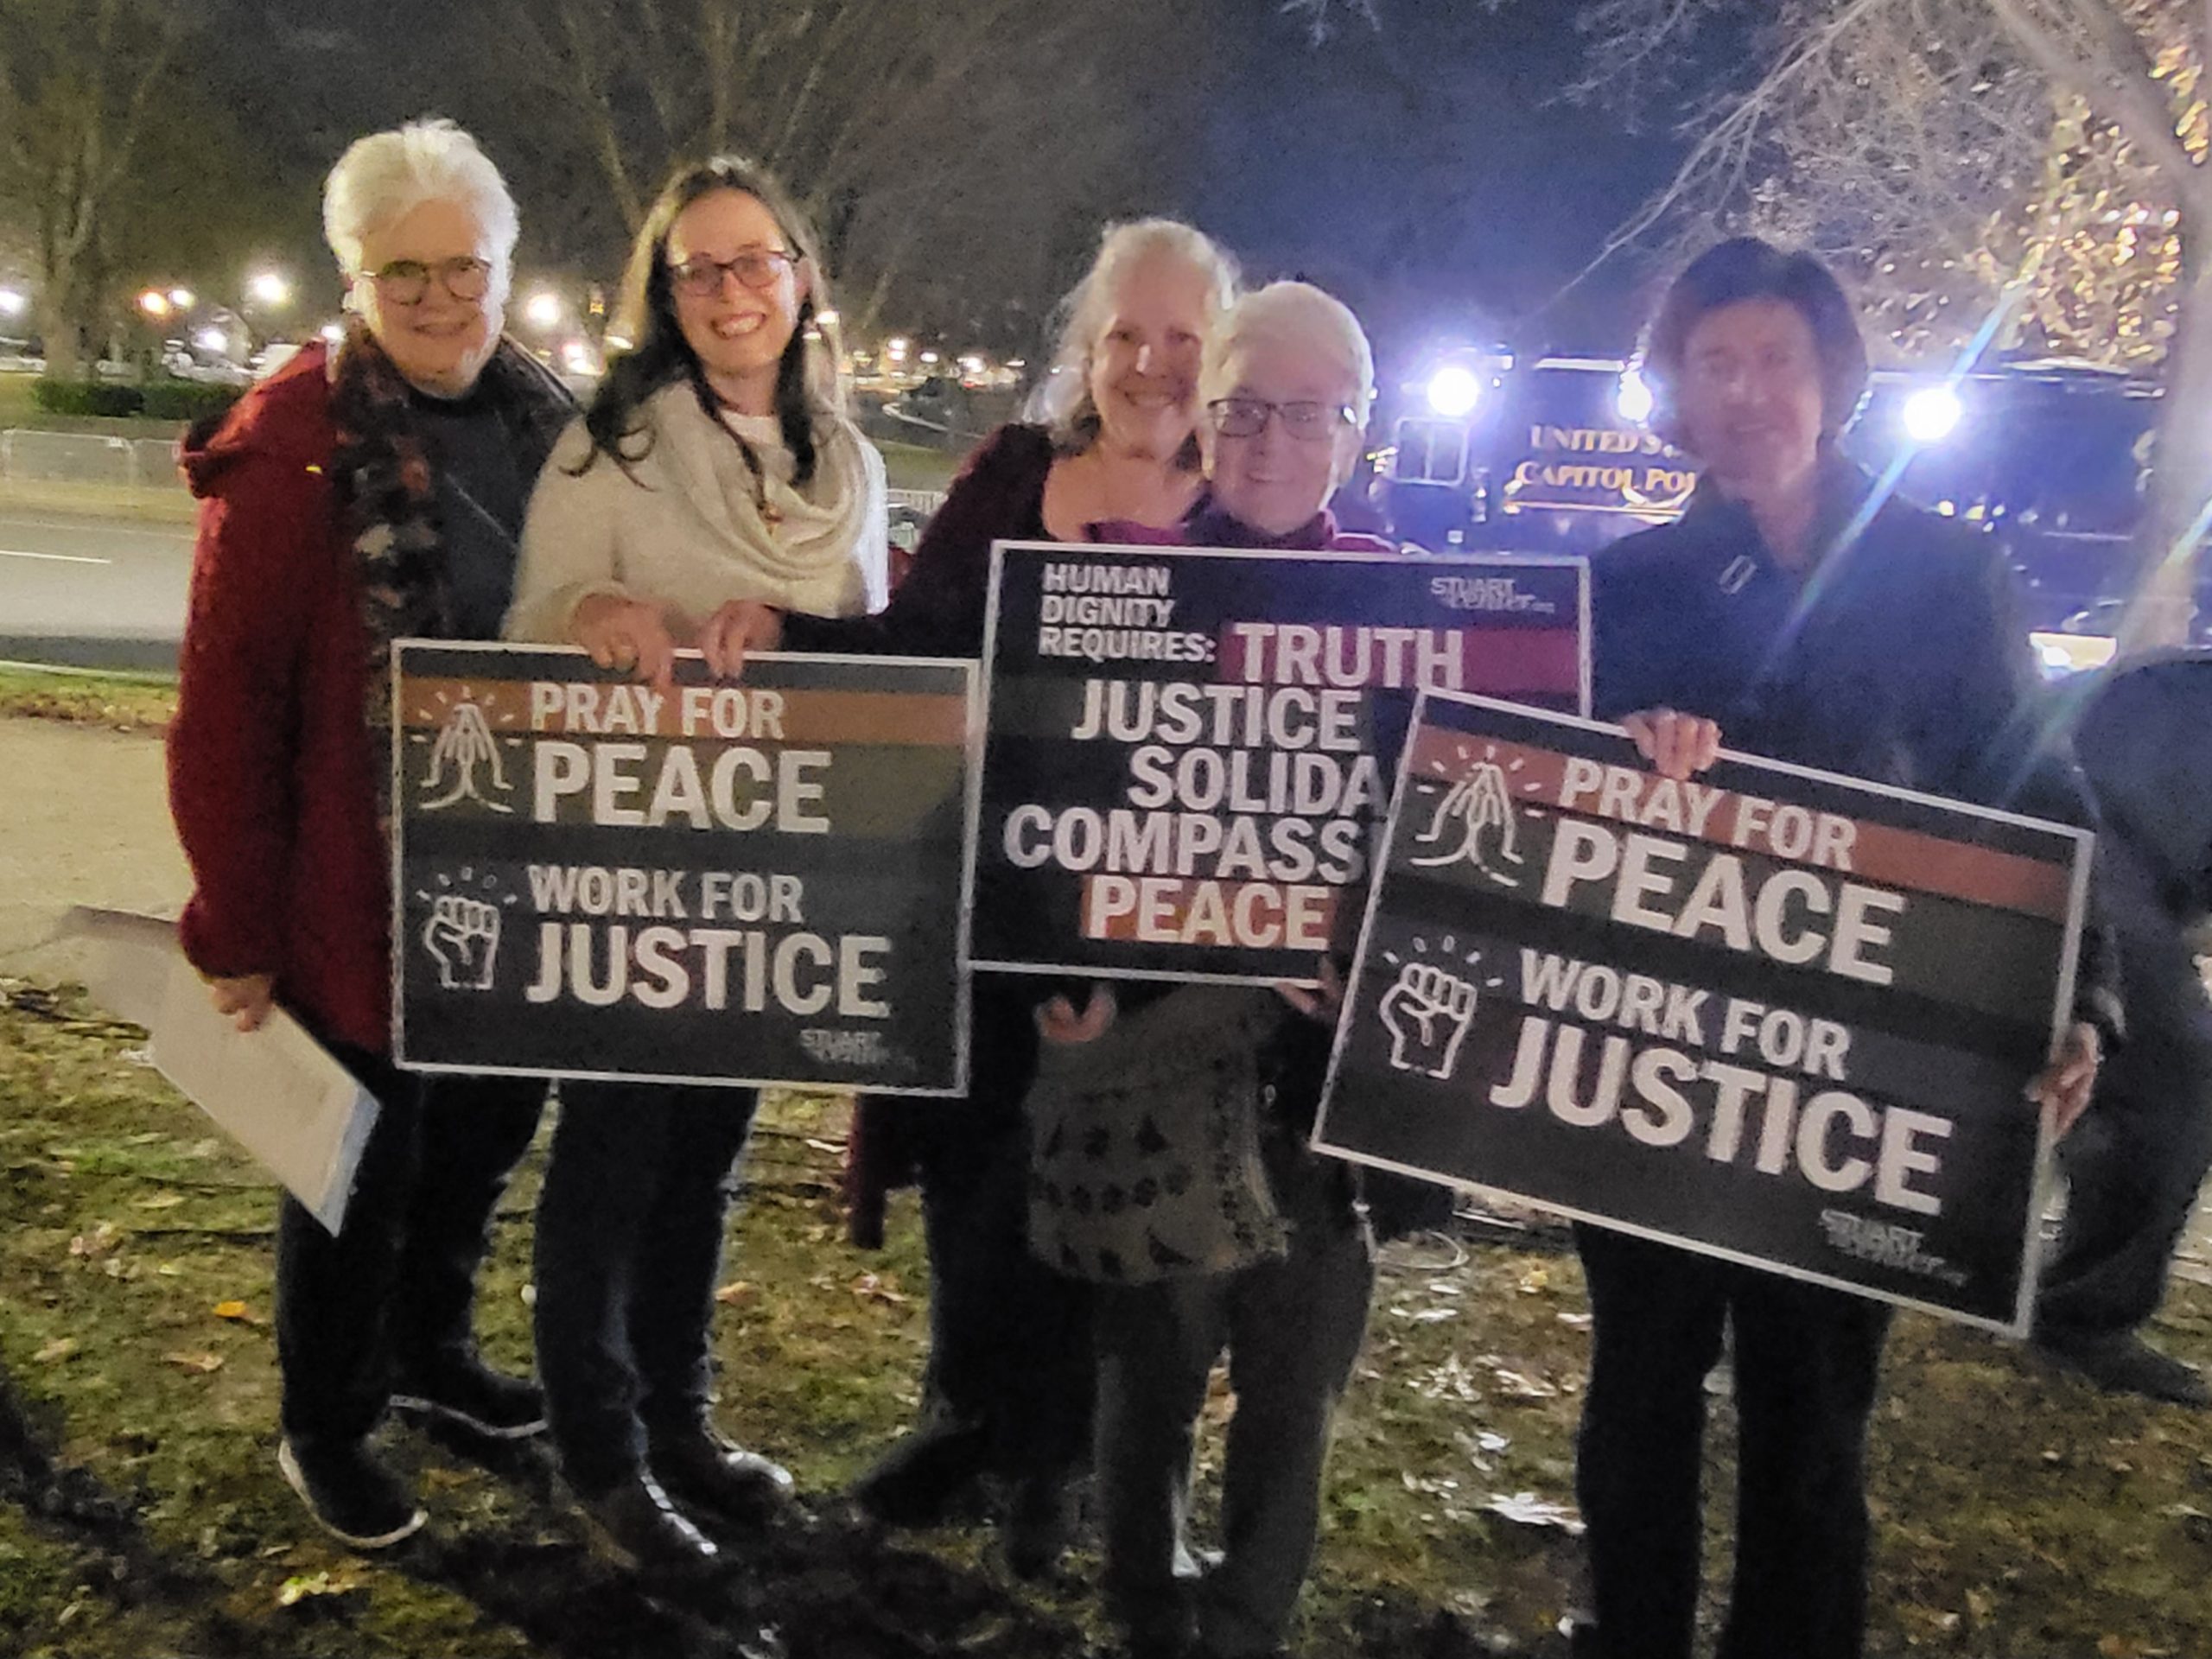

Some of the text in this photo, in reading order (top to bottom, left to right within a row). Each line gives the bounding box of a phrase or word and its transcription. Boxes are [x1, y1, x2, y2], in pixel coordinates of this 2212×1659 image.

[1514, 461, 1633, 490] CAPITOL
[1530, 424, 1639, 454] UNITED
[1041, 594, 1176, 628] DIGNITY
[1042, 563, 1172, 596] HUMAN
[1038, 621, 1465, 691] REQUIRES: TRUTH
[530, 681, 785, 740] PRAY FOR
[1071, 678, 1363, 752] JUSTICE
[532, 741, 834, 835] PEACE
[1126, 747, 1387, 817] SOLIDA
[1557, 756, 1859, 872] PRAY FOR
[1002, 804, 1364, 886] COMPASS
[527, 863, 804, 924] WORK FOR
[1086, 874, 1331, 951] PEACE
[1541, 819, 1906, 986] PEACE
[524, 921, 893, 1019] JUSTICE
[1518, 947, 1853, 1082] WORK FOR
[1487, 1016, 1953, 1217] JUSTICE
